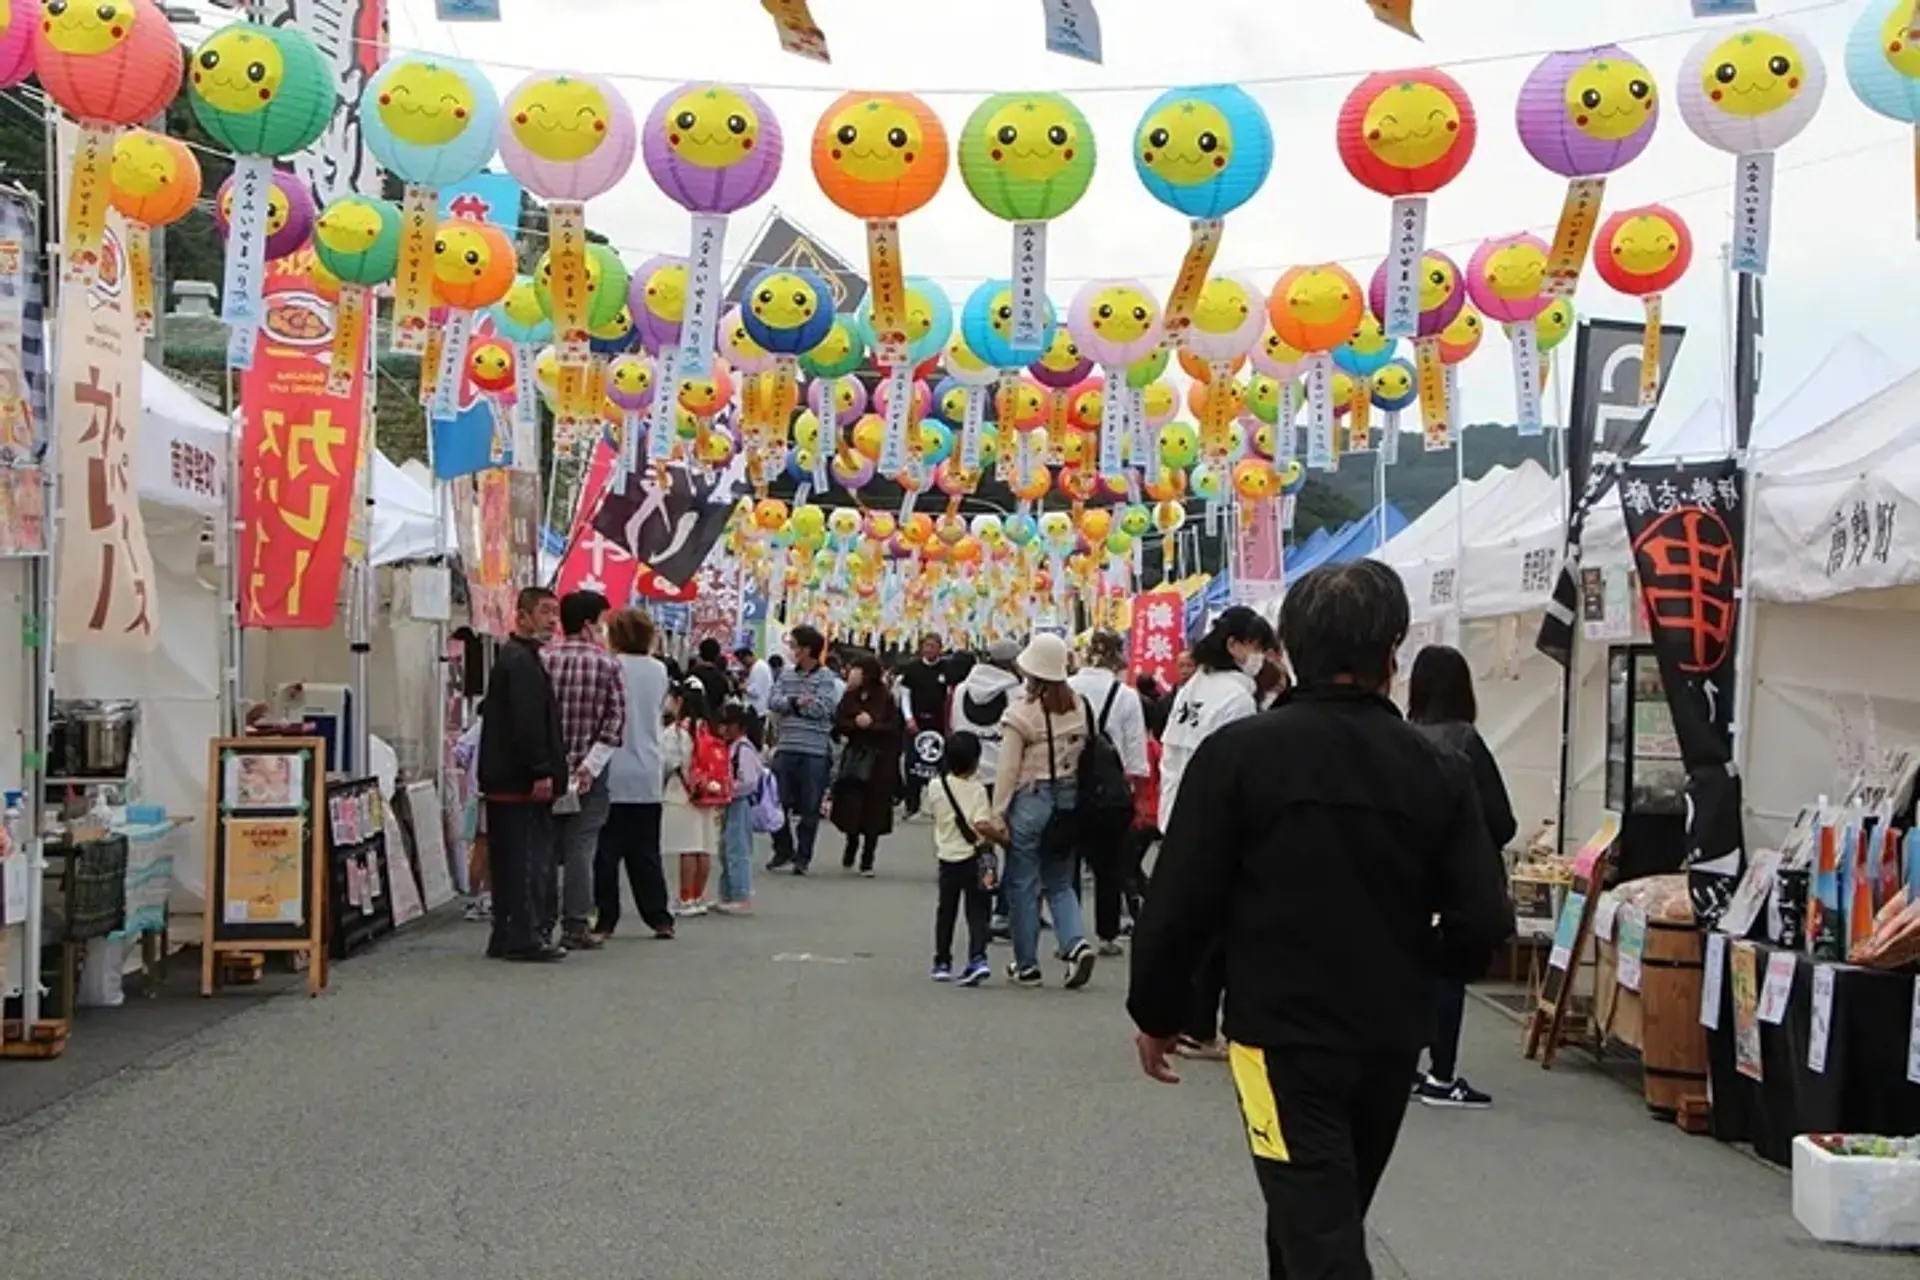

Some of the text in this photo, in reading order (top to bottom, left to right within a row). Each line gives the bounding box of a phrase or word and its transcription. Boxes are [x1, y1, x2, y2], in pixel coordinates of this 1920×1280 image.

[1743, 162, 1760, 246] みなみいせまつり
[689, 227, 714, 346] みなみいせまつり
[1021, 226, 1036, 320] みなみいせまつり
[1398, 207, 1418, 306] みなみいせまつり
